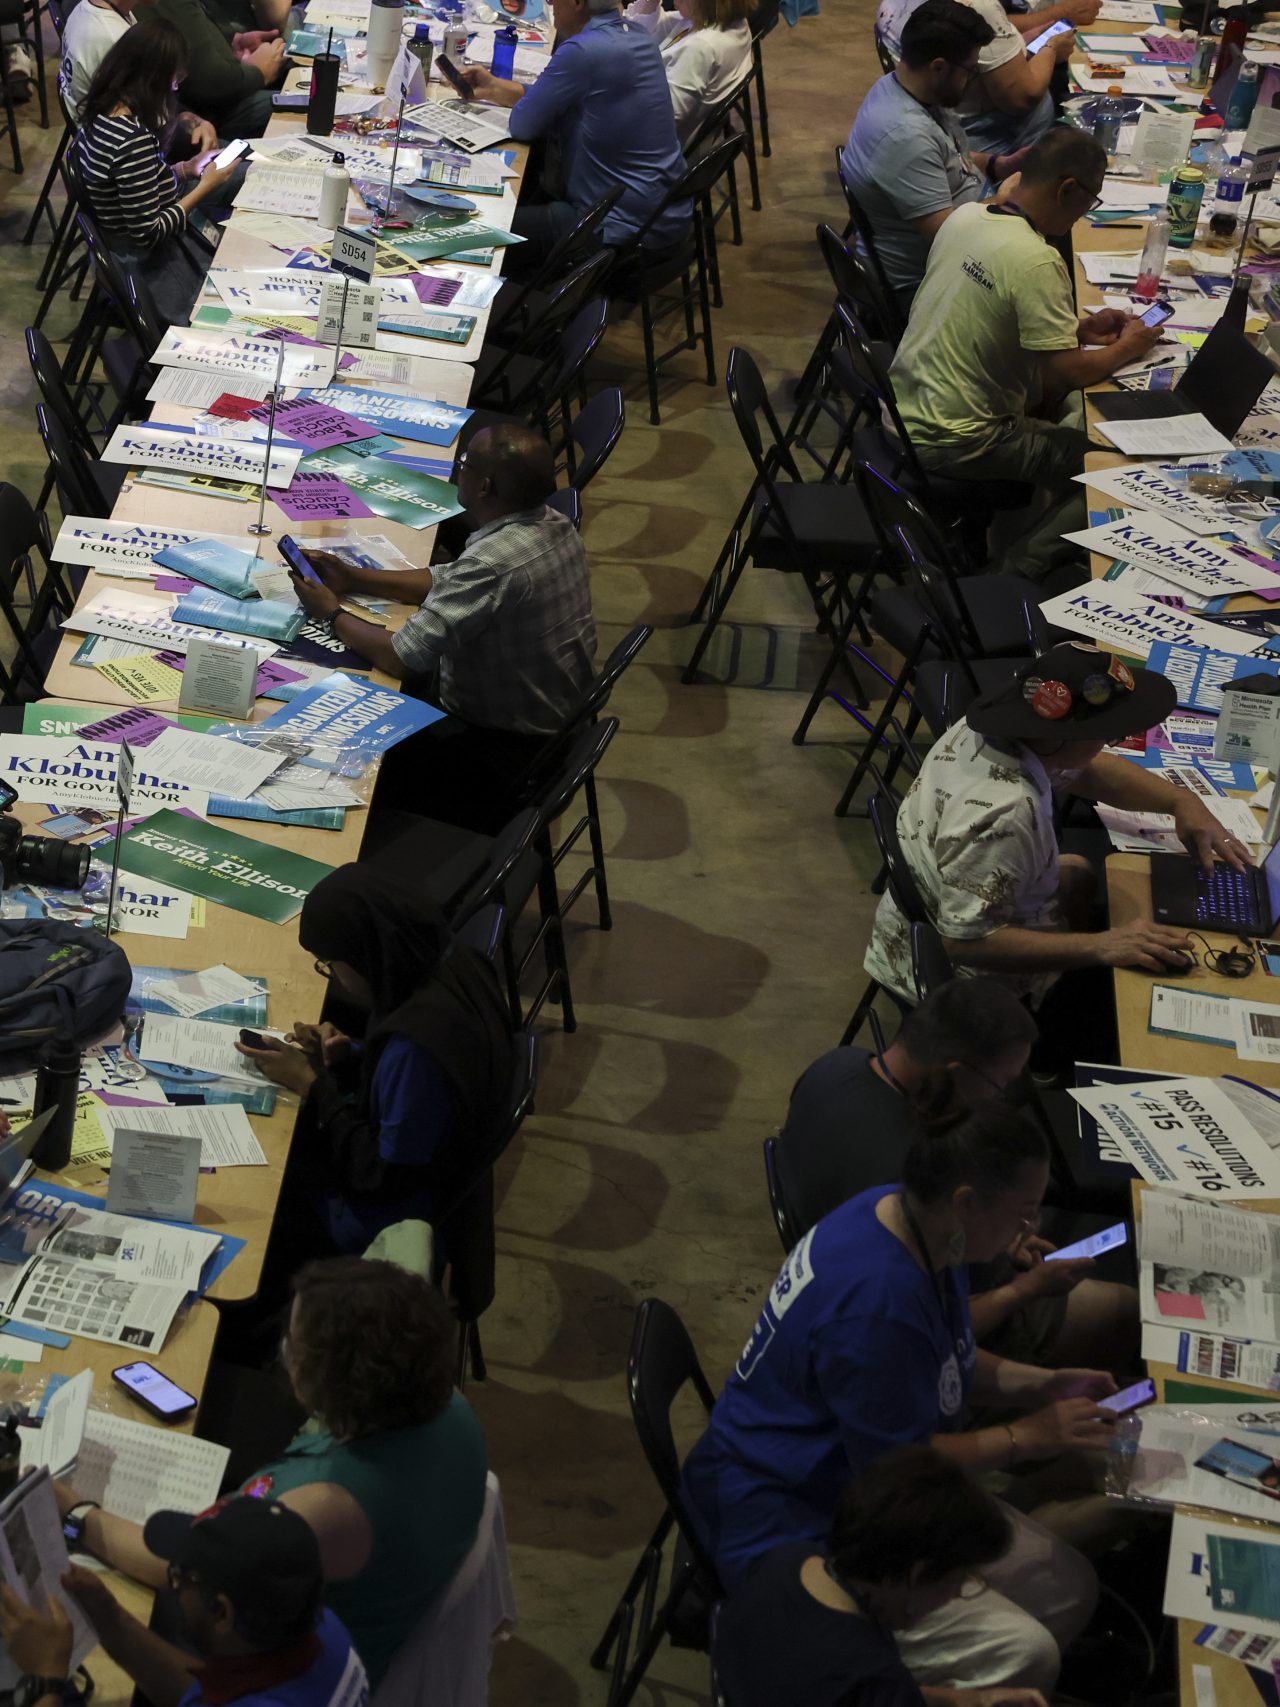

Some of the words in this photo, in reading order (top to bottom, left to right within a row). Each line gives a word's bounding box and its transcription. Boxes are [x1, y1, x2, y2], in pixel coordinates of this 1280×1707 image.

[341, 241, 367, 262] SD54
[962, 262, 994, 290] FLANAGAN
[171, 341, 328, 373] Klobucar
[221, 337, 287, 355] Amy
[177, 354, 215, 367] FOR
[218, 360, 311, 379] GOVEROR
[288, 415, 346, 435] CAUCUS
[430, 403, 464, 421] BY
[307, 422, 353, 439] LABOR
[120, 439, 287, 471] Klobuchar
[172, 436, 243, 453] Amy
[128, 449, 164, 462] FOR
[167, 454, 267, 475] GOVERNOR
[368, 480, 457, 515] Ellison
[1113, 477, 1142, 494] FOR
[281, 495, 350, 505] CAUCUS
[296, 502, 351, 511] LABOR
[120, 526, 199, 544] Amy
[79, 542, 119, 555] FOR
[1102, 536, 1136, 552] FOR
[1135, 551, 1219, 586] GOVERNOR
[1111, 525, 1251, 587] Klobuchar
[1170, 540, 1239, 567] Amy
[91, 604, 269, 651] Klobuchar
[96, 618, 135, 634] FOR
[1063, 608, 1101, 624] FOR
[1067, 595, 1221, 652] Klobucha
[1127, 604, 1204, 632] Amy
[280, 688, 354, 736] RGANIZED
[1241, 695, 1273, 705] Minnesota
[17, 775, 42, 788] FOR
[128, 831, 210, 866] Keith
[173, 857, 207, 873] Afford
[207, 868, 232, 881] Your
[231, 877, 252, 888] Life
[1136, 1102, 1184, 1131] #15
[1105, 1110, 1136, 1138] ACTION
[1129, 1139, 1171, 1182] NETWORK
[1164, 1089, 1205, 1113] PASS
[1188, 1114, 1266, 1188] RESOLUTIONS
[71, 1153, 96, 1167] VOTE
[1183, 1159, 1231, 1192] #16
